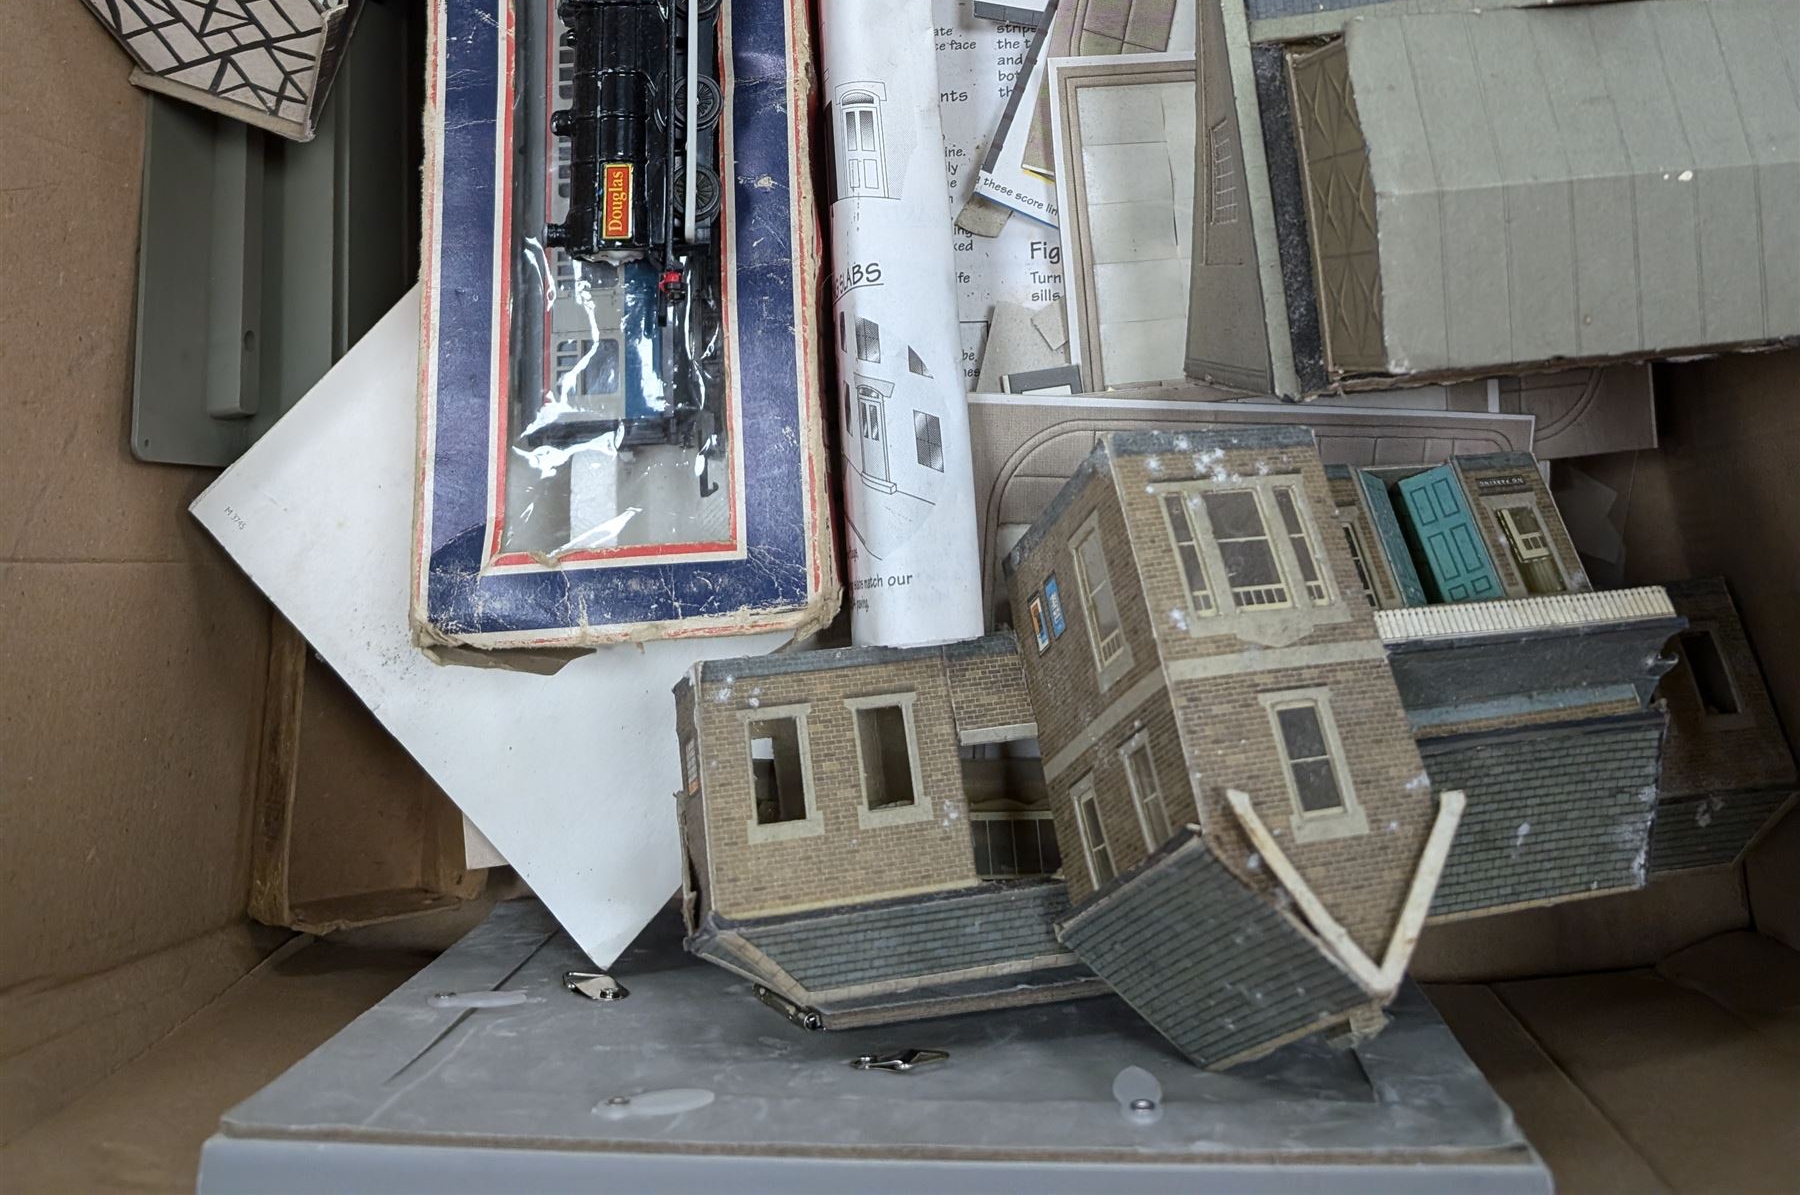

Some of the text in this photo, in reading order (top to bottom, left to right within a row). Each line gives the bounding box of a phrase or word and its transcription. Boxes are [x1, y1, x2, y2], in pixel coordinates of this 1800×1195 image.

[949, 39, 977, 51] face
[996, 38, 1020, 50] the
[997, 53, 1023, 66] and
[940, 90, 968, 103] nts
[983, 177, 1014, 196] these
[1014, 192, 1044, 210] score
[608, 170, 628, 232] Douglas
[1030, 241, 1060, 265] Fig
[1030, 270, 1062, 284] Turn
[1031, 289, 1061, 302] sills
[887, 574, 913, 587] our
